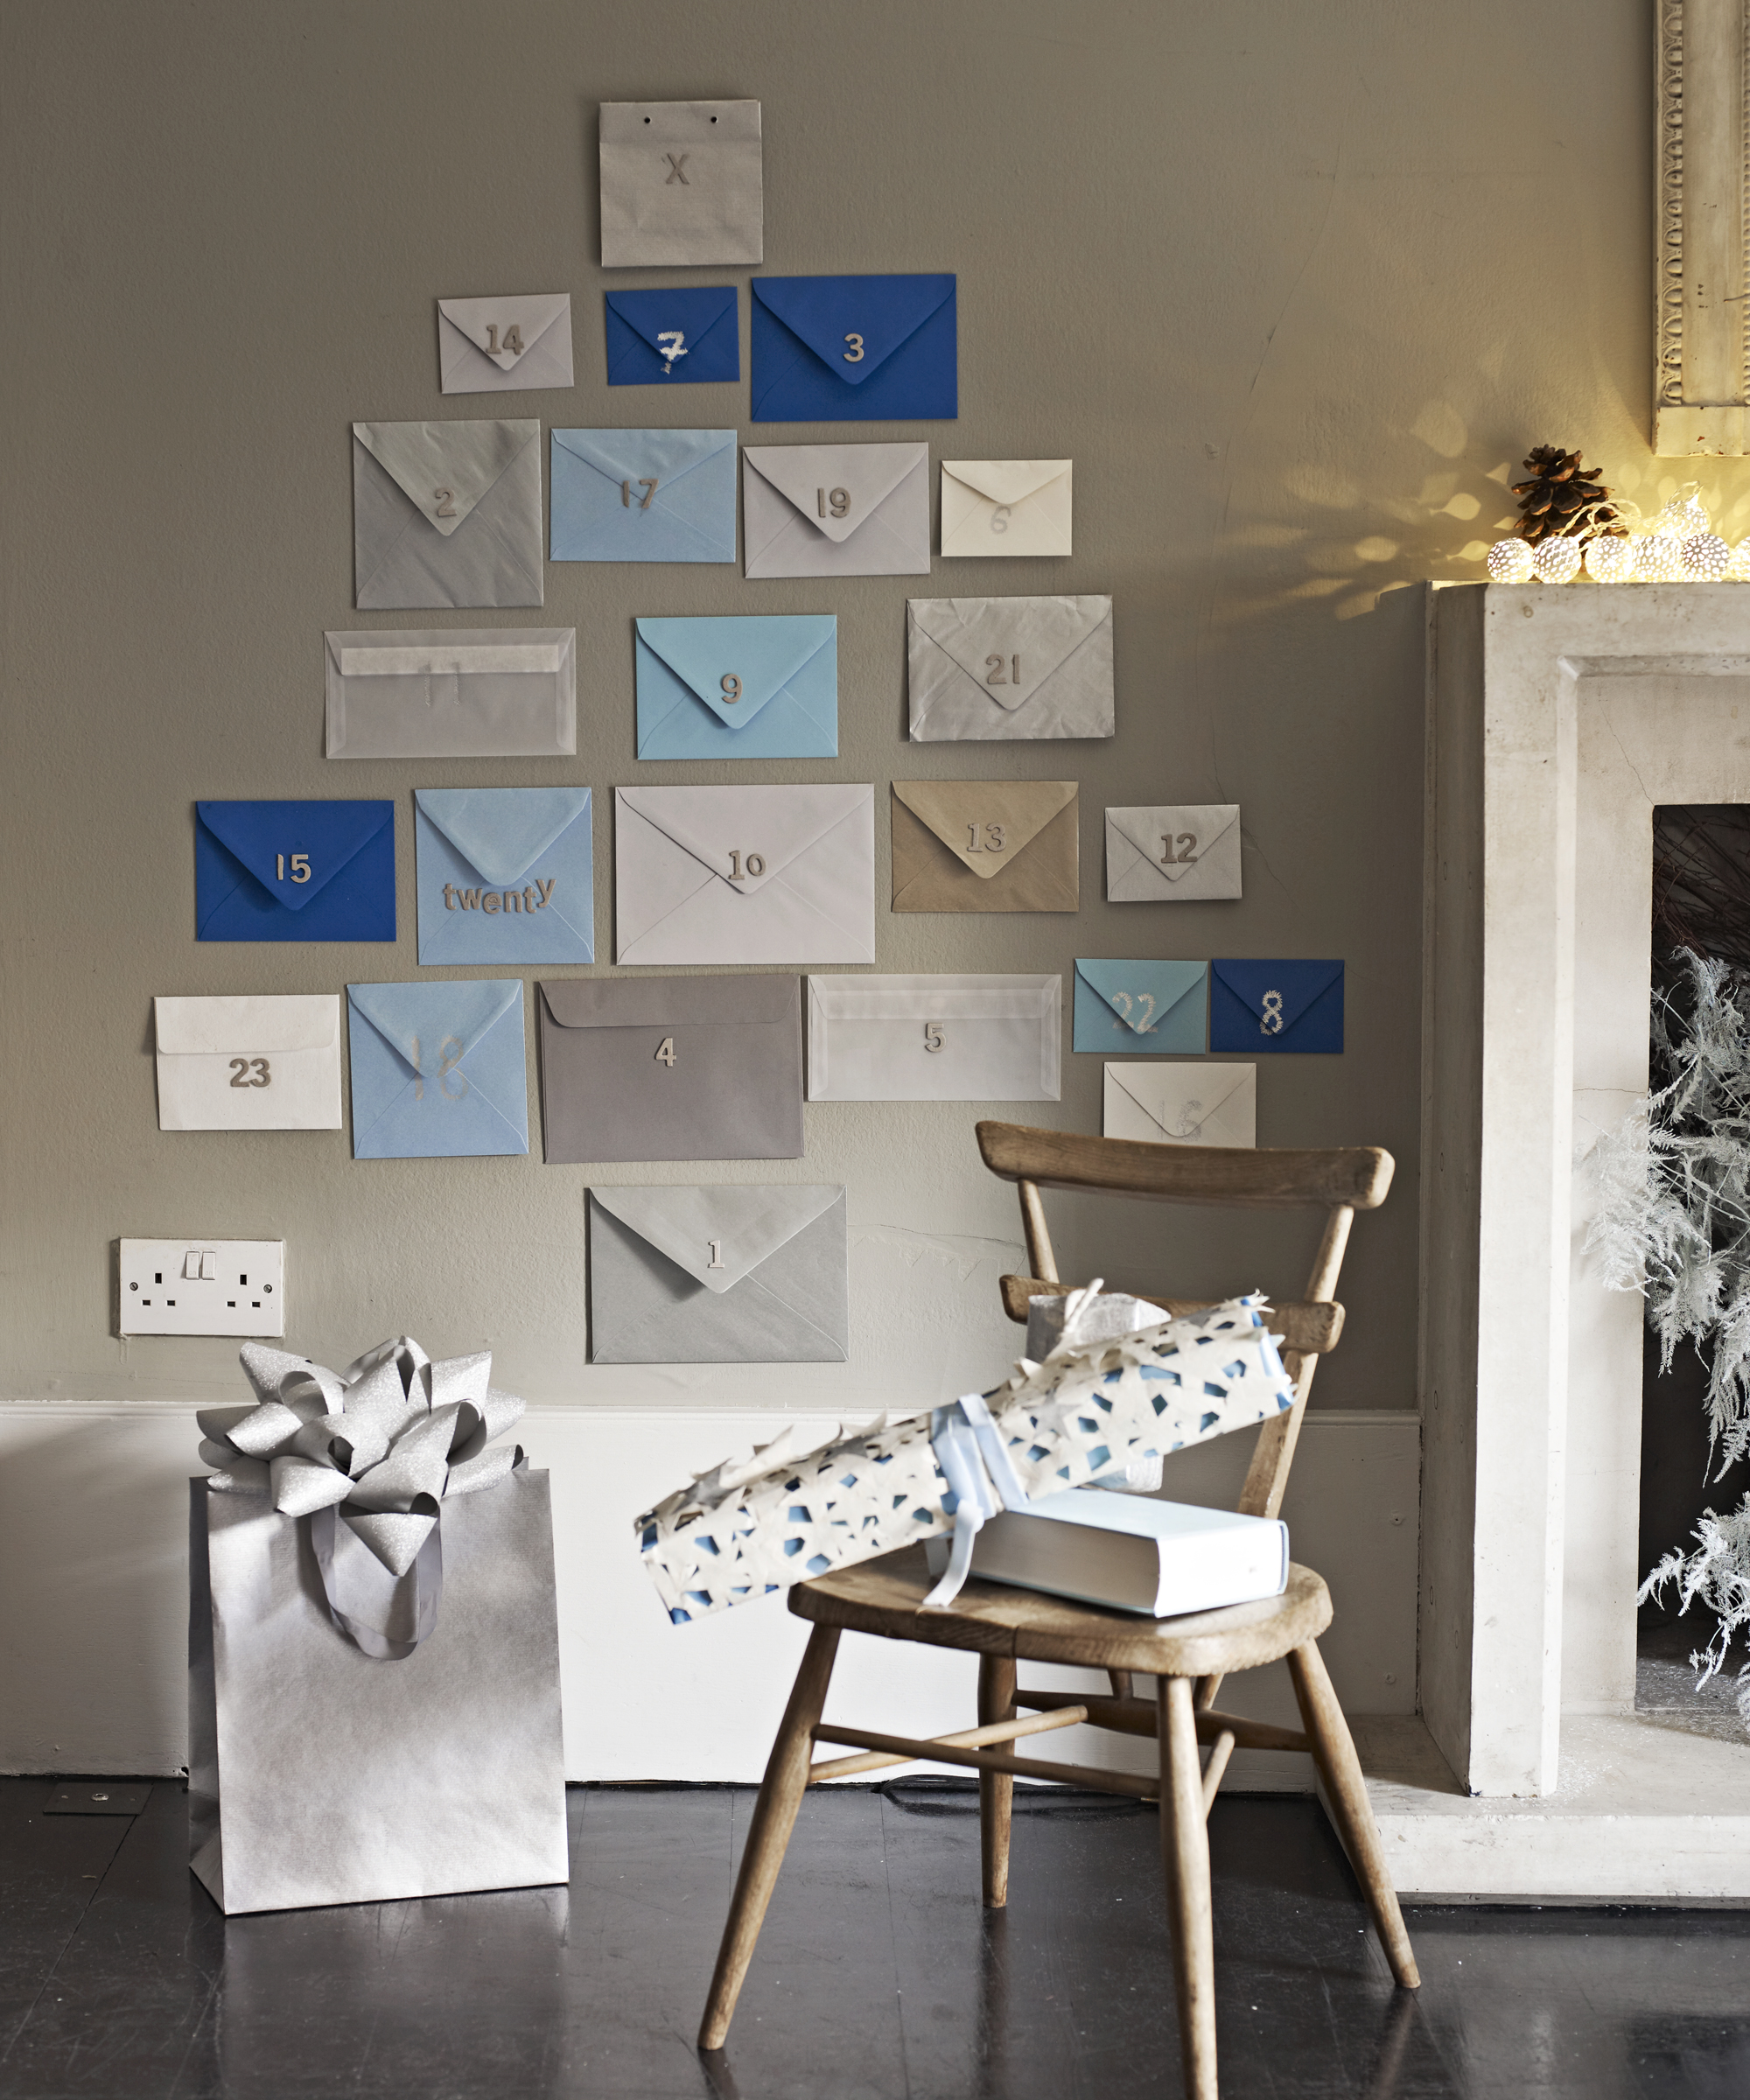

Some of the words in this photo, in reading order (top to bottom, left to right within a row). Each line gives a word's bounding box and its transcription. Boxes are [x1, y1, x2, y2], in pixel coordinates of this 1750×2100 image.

[664, 152, 689, 186] X
[485, 325, 524, 355] 14
[656, 330, 688, 374] 7
[843, 332, 865, 362] 3
[435, 486, 458, 518] 2
[621, 478, 659, 509] 17
[816, 486, 852, 519] 19
[990, 505, 1012, 535] 6
[987, 653, 1021, 687] 21
[720, 674, 743, 704] 9
[966, 822, 1007, 854] 13
[1160, 832, 1199, 864] 12
[276, 853, 312, 885] 15
[444, 878, 556, 915] twenty
[1112, 990, 1158, 1034] 22
[1259, 989, 1284, 1036] 8
[654, 1037, 678, 1068] 4
[925, 1022, 948, 1054] 5
[228, 1057, 272, 1088] 23
[411, 1034, 469, 1101] 18
[1157, 1099, 1205, 1144] 16
[707, 1239, 726, 1270] 1
